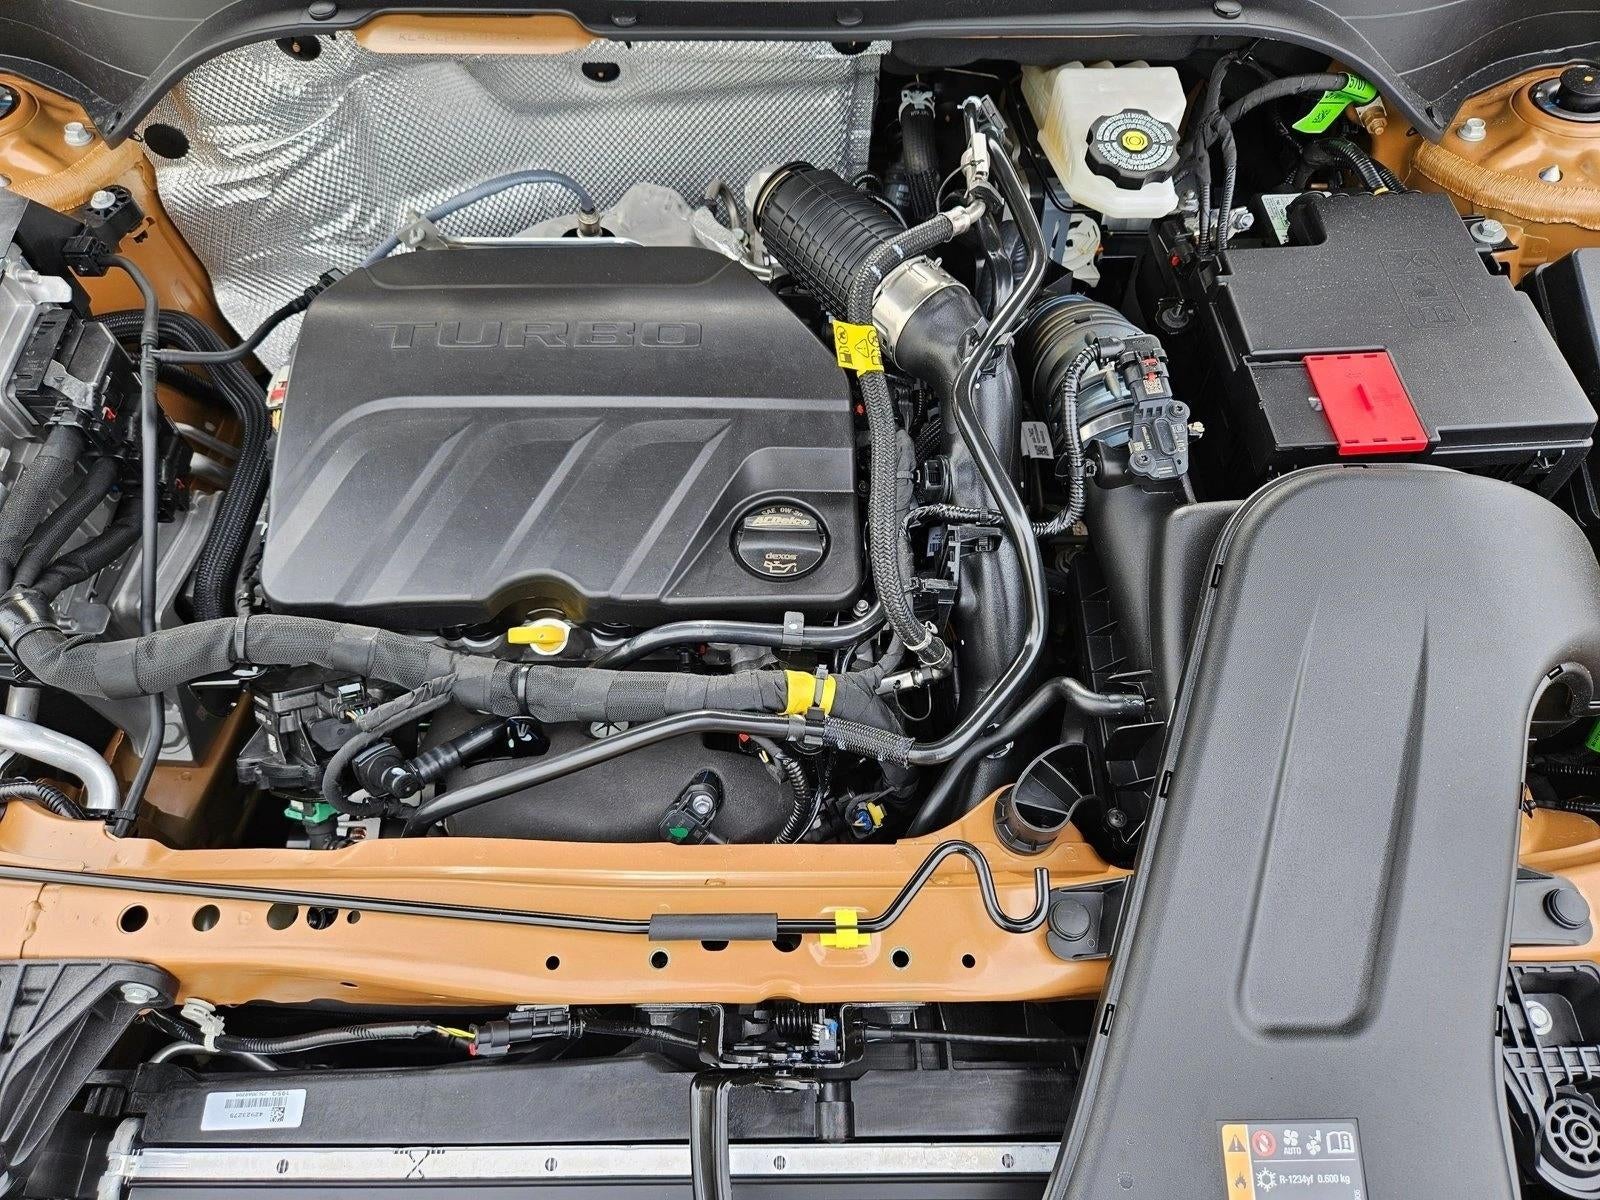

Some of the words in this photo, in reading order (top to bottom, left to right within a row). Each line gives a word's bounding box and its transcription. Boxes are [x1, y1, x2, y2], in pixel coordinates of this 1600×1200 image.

[1118, 161, 1134, 170] FROM
[370, 321, 703, 349] TURBO
[761, 507, 777, 516] SAE
[780, 507, 804, 517] 0W-20
[752, 516, 811, 527] ACDelco
[765, 552, 798, 560] dexos
[1284, 1147, 1302, 1155] AUTO
[1279, 1174, 1314, 1186] R-1234yf
[1340, 1173, 1351, 1185] kg
